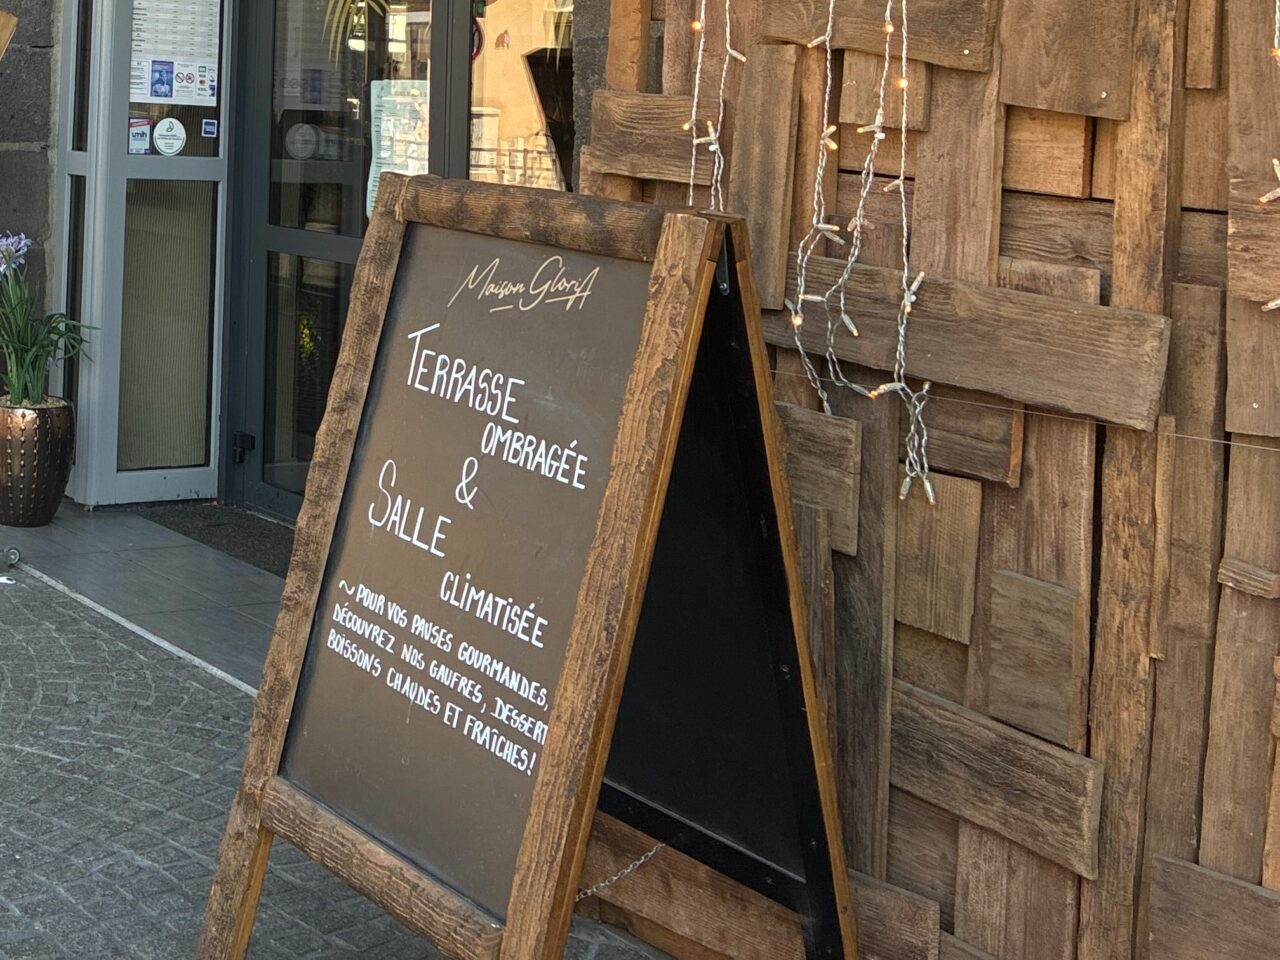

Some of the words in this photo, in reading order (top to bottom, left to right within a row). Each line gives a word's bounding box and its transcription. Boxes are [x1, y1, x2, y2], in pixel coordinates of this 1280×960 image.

[447, 257, 526, 310] Maison
[407, 322, 526, 424] TERRASSE
[455, 456, 479, 511] &
[481, 421, 589, 490] OMBRAGÉE
[368, 459, 452, 558] SALLE
[332, 602, 396, 654] DÉCOUVREZ
[400, 643, 425, 670] NOS
[429, 659, 487, 713] GAUFRES,
[387, 601, 408, 628] VOS
[411, 614, 454, 653] PAUSES
[457, 642, 550, 712] GOURMANDES,
[386, 667, 441, 715] CHAUDES
[443, 701, 463, 729] ET
[463, 716, 537, 777] FRAÎCHES!
